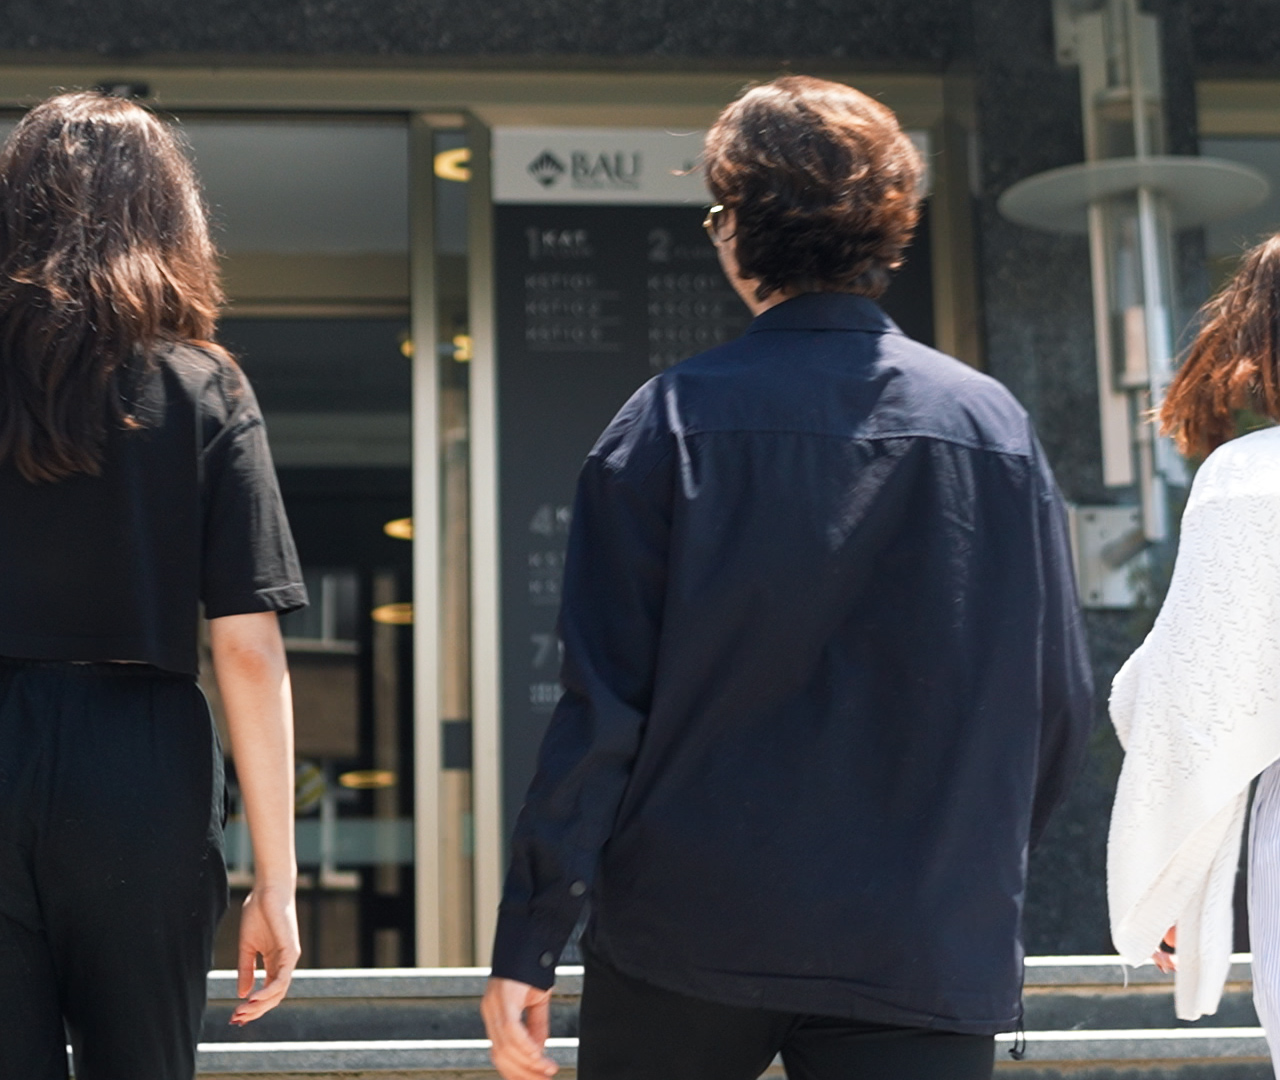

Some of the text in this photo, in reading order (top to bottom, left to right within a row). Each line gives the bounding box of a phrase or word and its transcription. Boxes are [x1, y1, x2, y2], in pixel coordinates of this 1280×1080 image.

[571, 151, 641, 179] BAU
[648, 228, 671, 262] 2
[529, 633, 553, 668] 7
